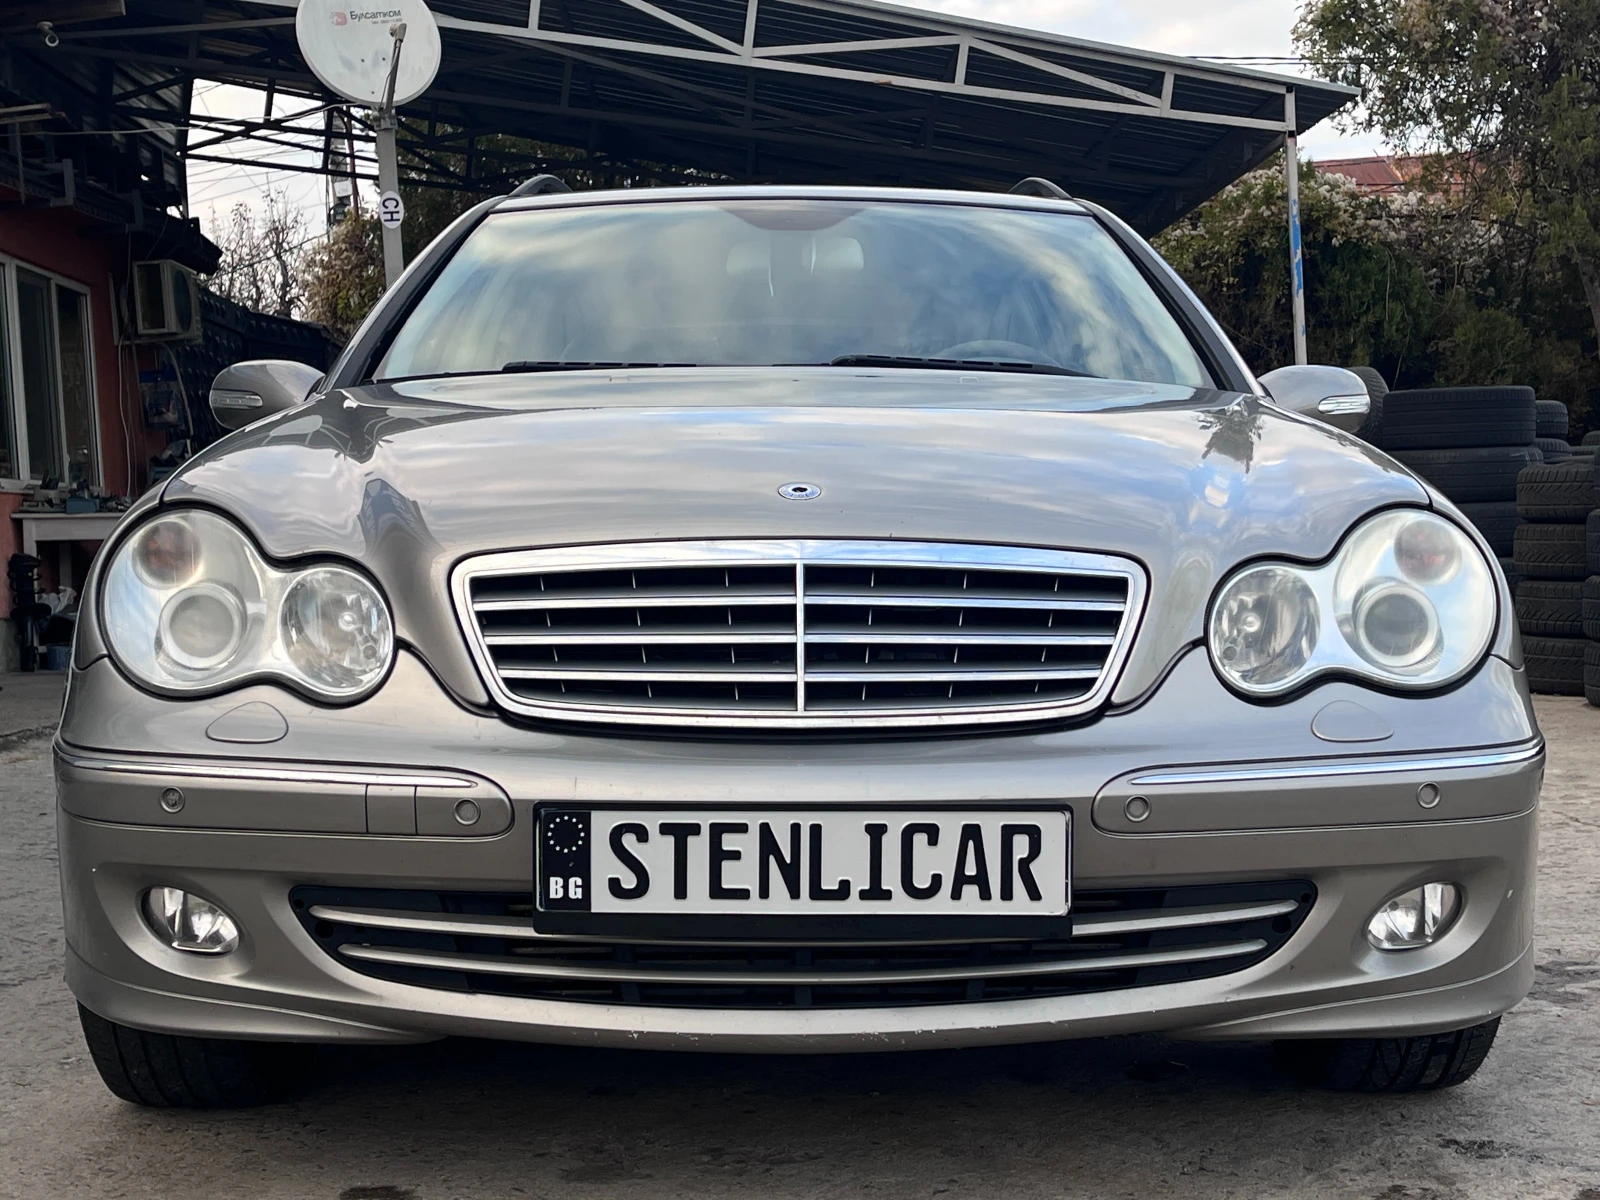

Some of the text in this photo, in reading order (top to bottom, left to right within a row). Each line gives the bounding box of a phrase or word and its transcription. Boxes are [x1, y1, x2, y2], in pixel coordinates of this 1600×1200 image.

[382, 198, 400, 222] CH
[607, 821, 1043, 901] STENLICAR
[549, 876, 583, 900] BG
